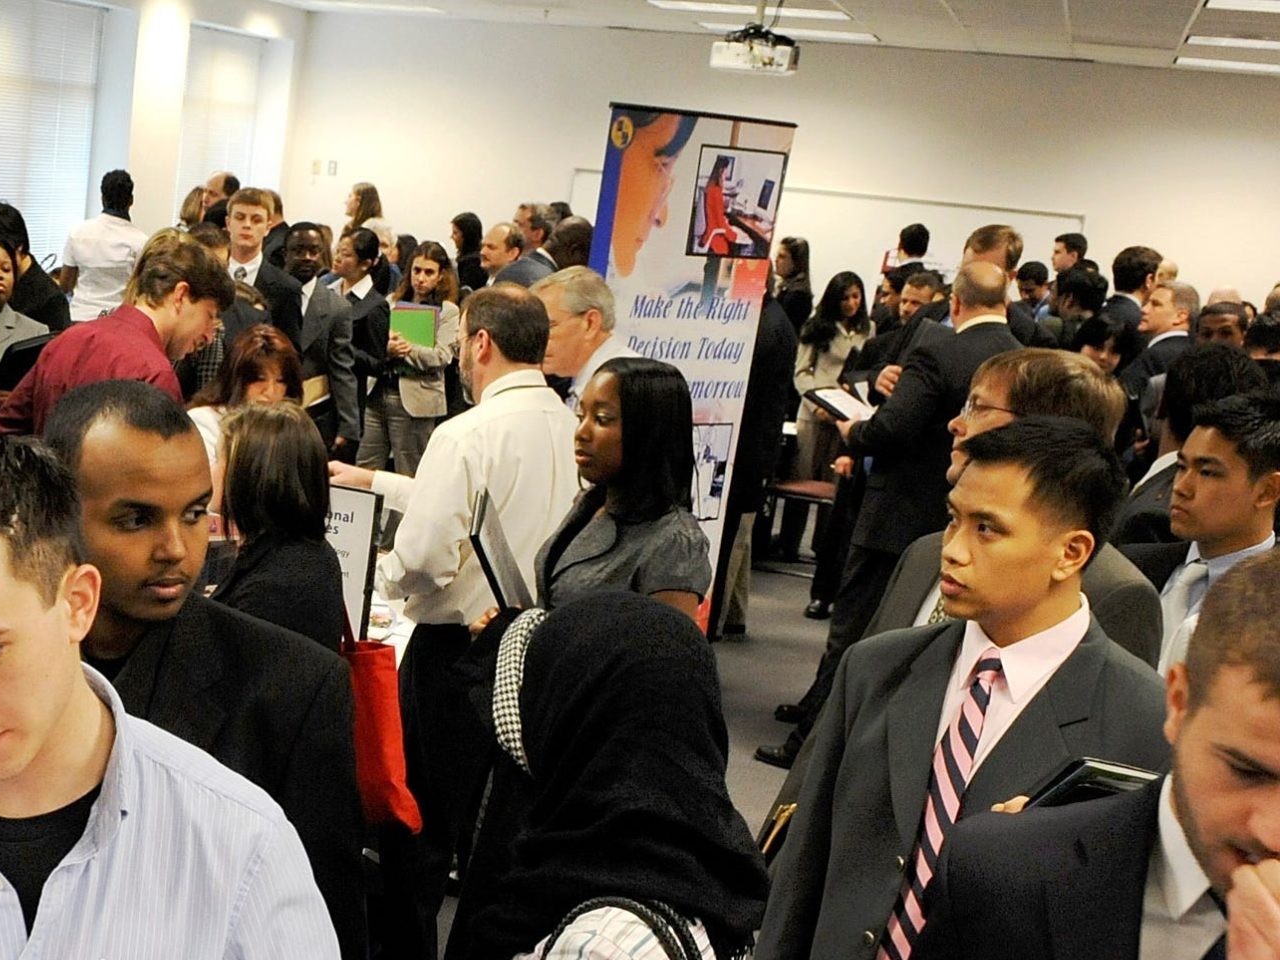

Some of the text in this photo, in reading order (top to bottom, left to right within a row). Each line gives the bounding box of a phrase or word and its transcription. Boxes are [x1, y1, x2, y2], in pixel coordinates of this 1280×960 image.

[629, 294, 751, 325] Make the Right
[697, 337, 745, 364] Today
